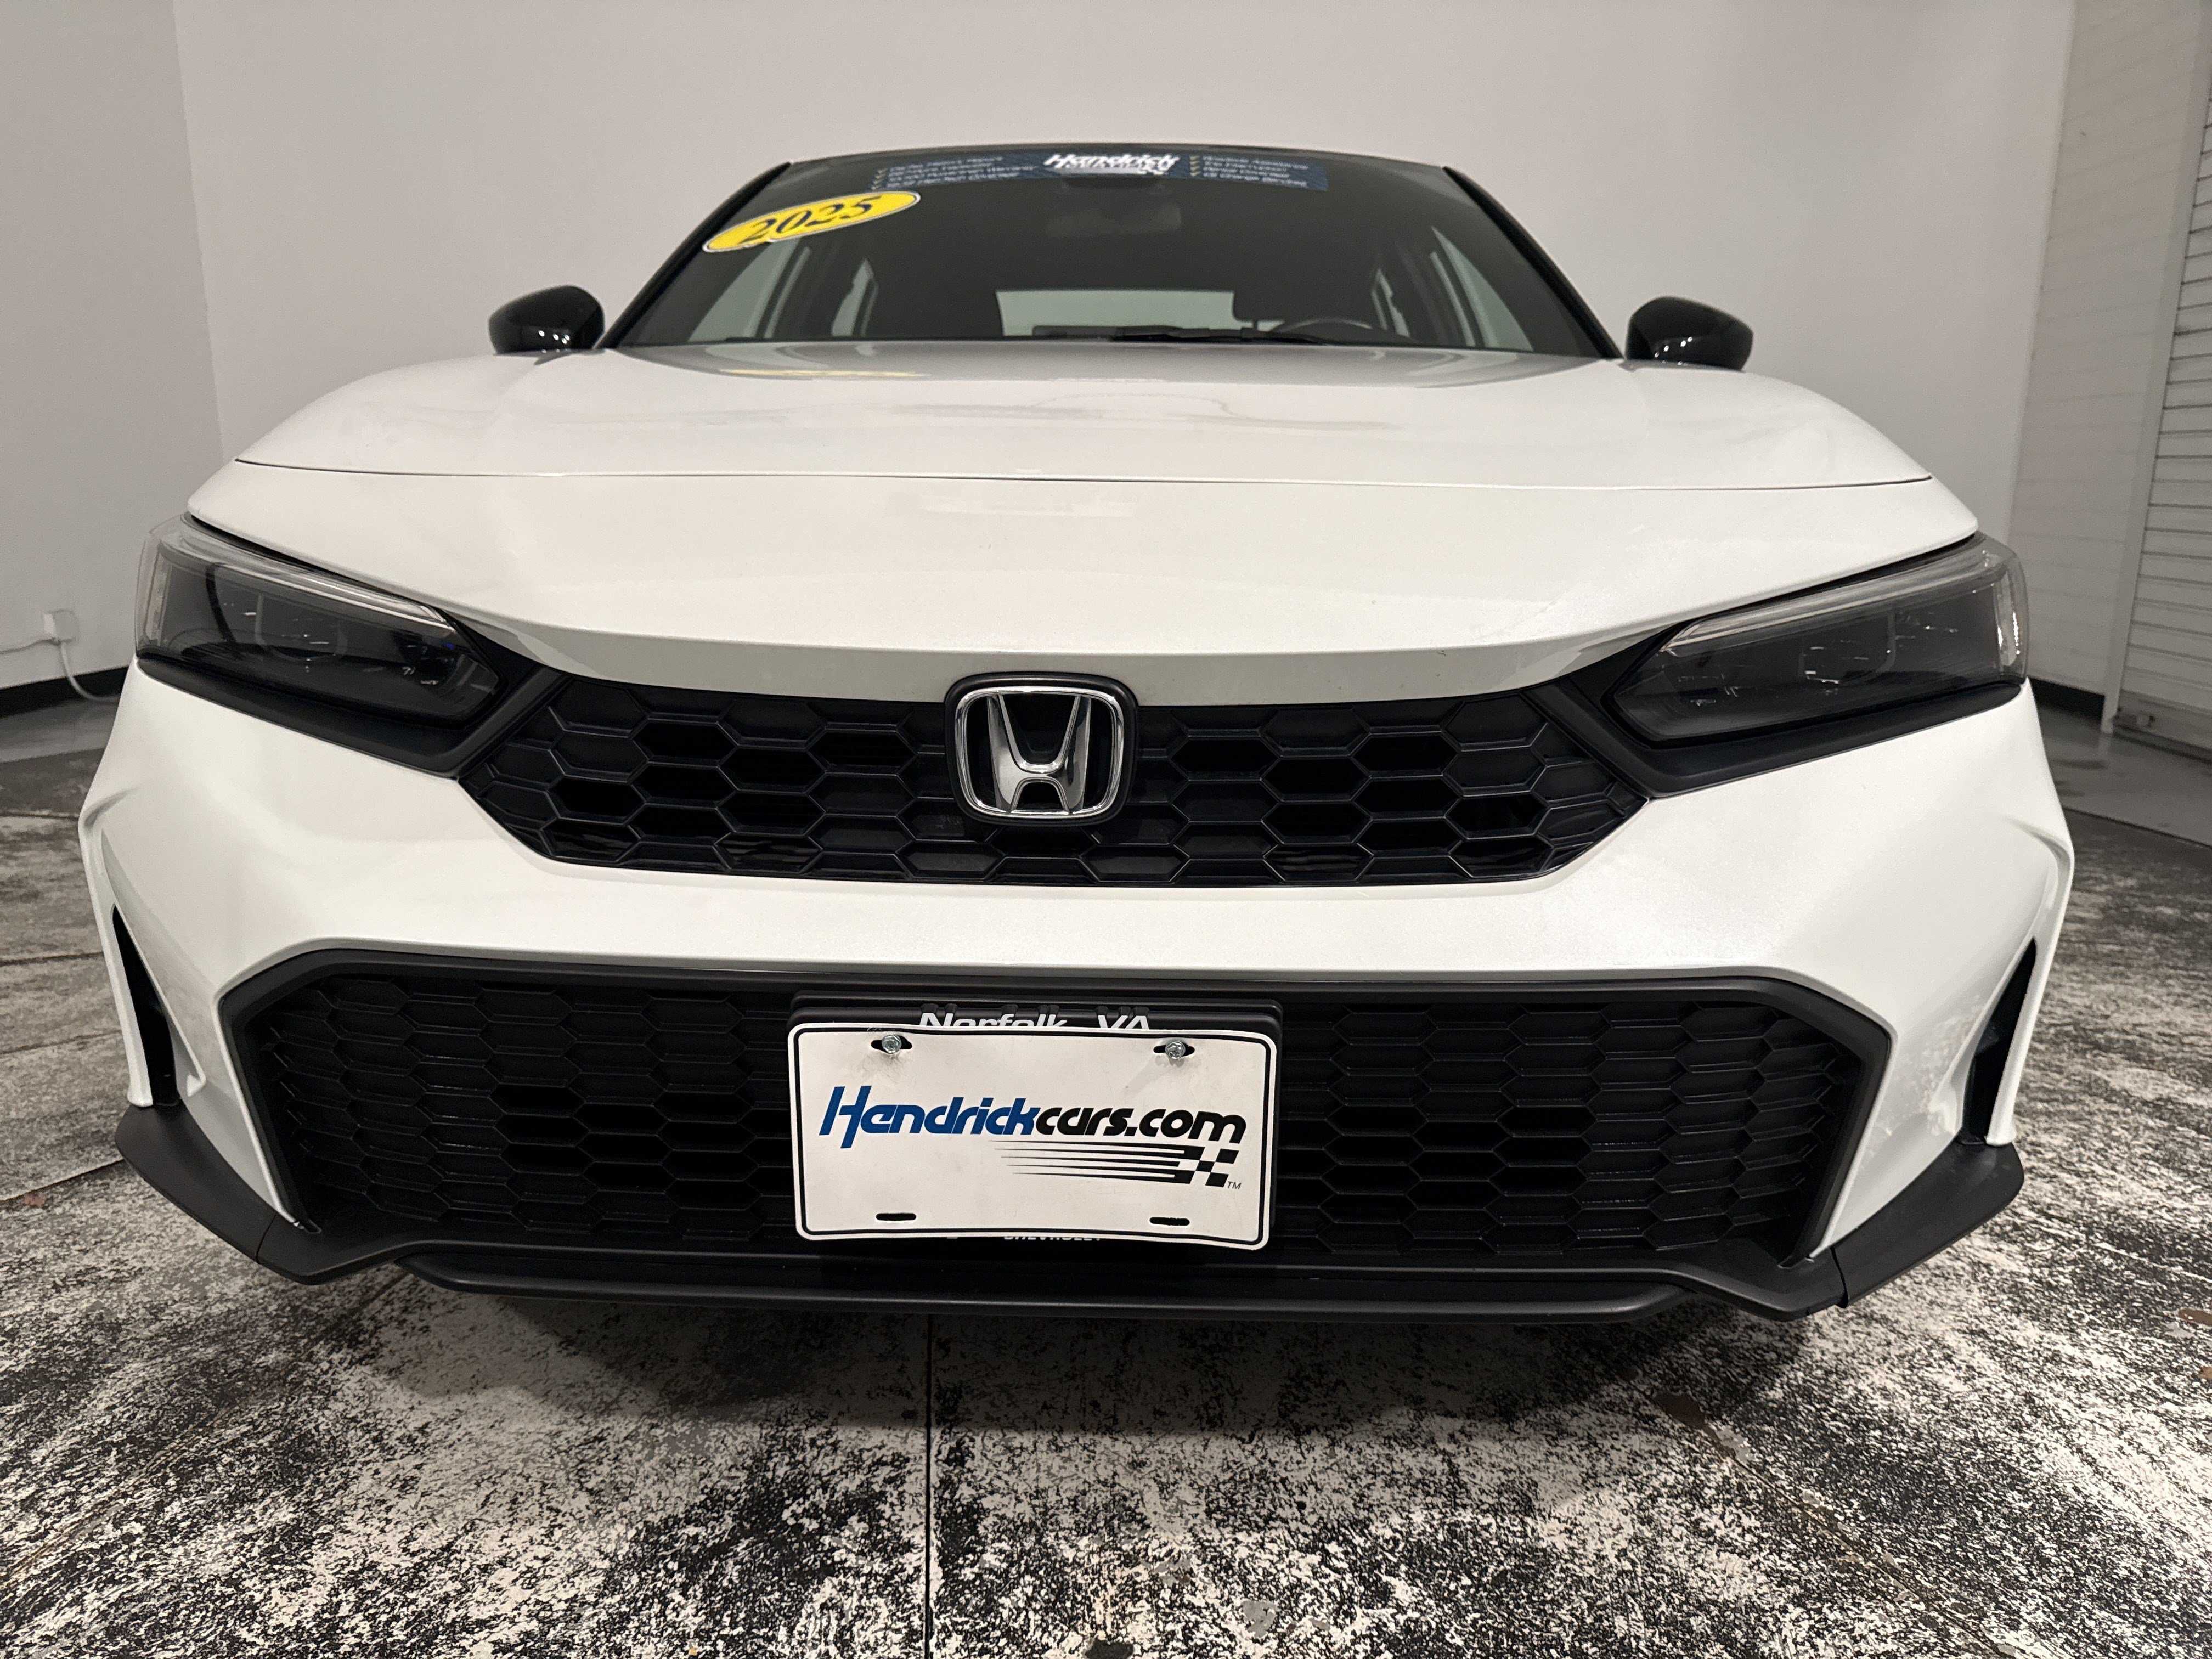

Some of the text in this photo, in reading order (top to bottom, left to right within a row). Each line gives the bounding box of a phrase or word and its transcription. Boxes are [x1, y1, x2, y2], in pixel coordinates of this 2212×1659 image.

[737, 195, 882, 244] 2025
[819, 1085, 1246, 1149] Hendrickcars.com
[1227, 1181, 1242, 1190] TM
